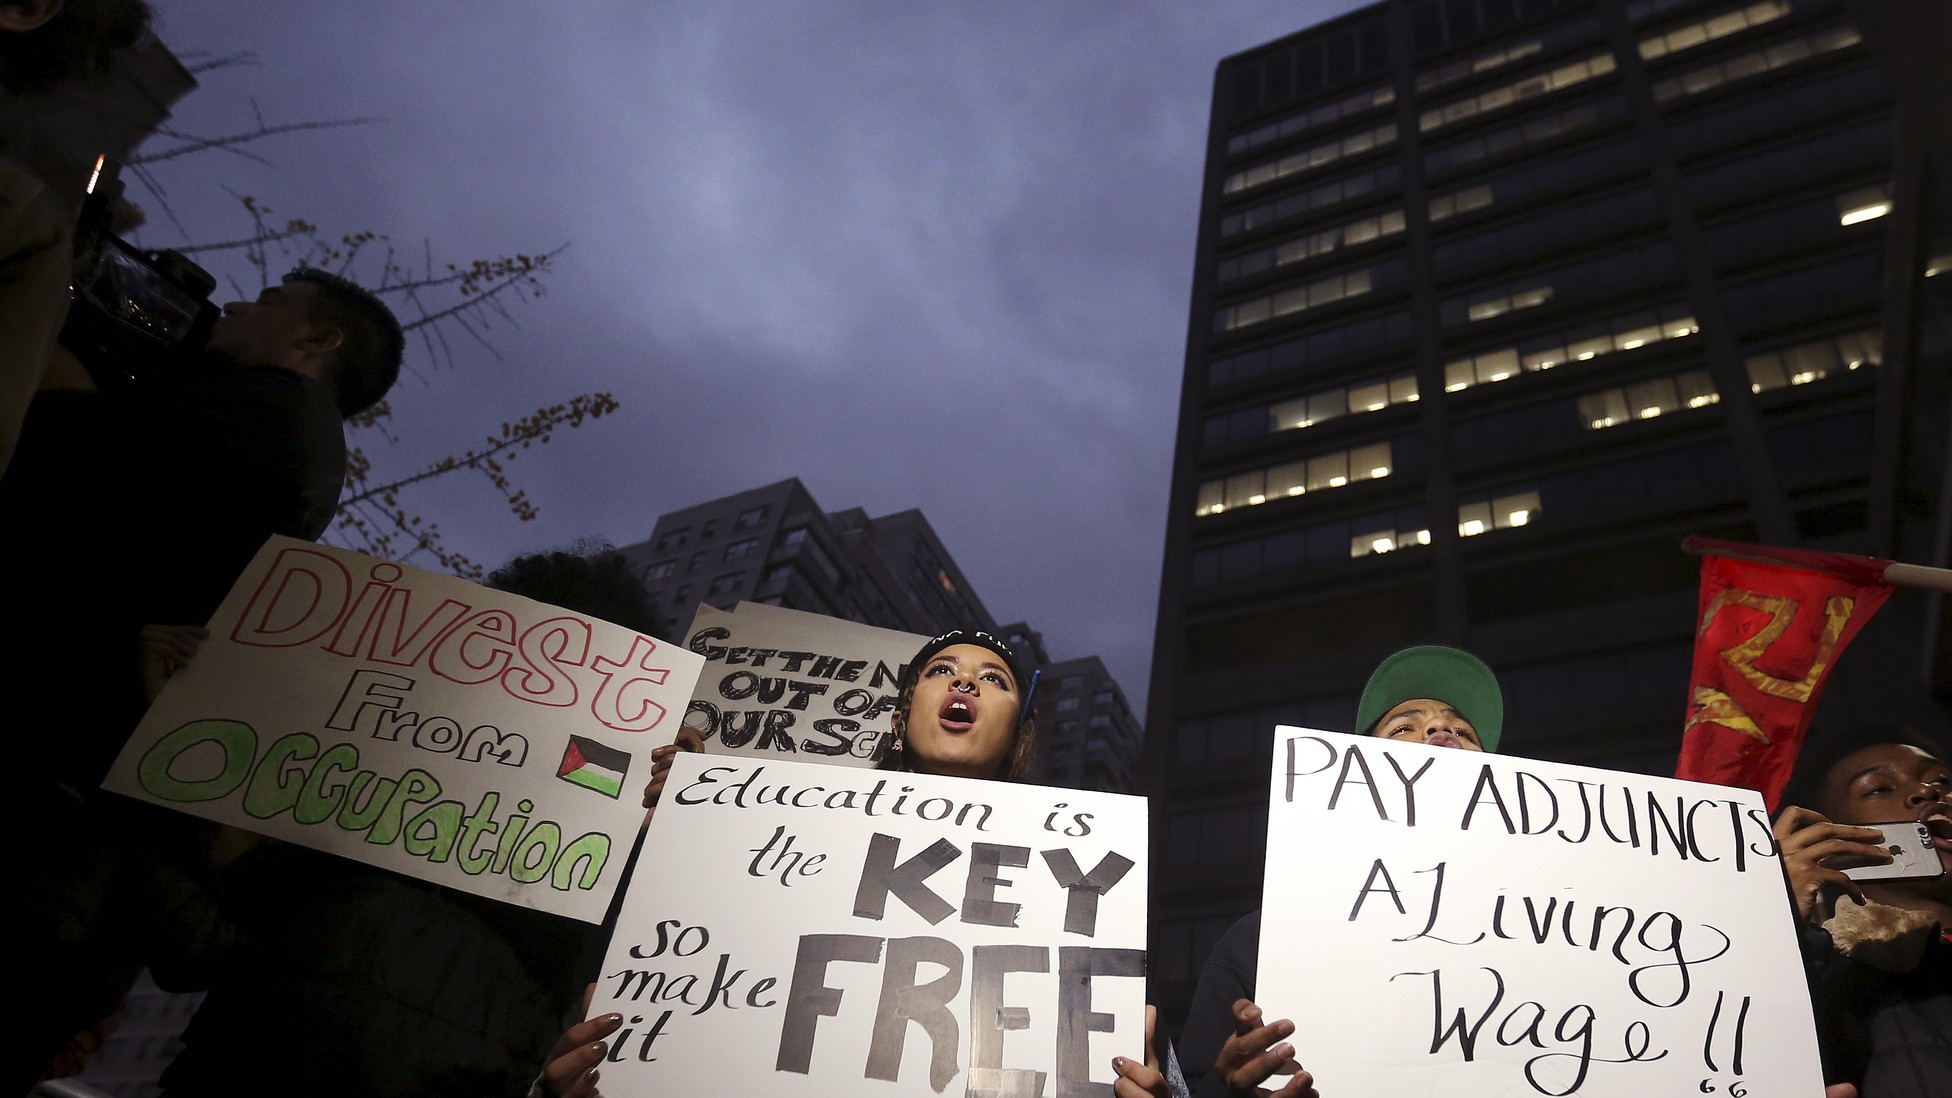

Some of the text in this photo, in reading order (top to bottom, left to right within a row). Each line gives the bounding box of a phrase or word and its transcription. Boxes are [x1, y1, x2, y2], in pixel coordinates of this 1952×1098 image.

[683, 700, 798, 753] OUR
[719, 671, 899, 721] OUT OF
[674, 766, 1095, 837] Education is
[1285, 736, 1778, 873] PAY ADJUNCTS
[748, 825, 1136, 938] the KEY
[629, 919, 709, 960] so
[1348, 858, 1730, 1008] A Living
[607, 954, 777, 1016] make
[775, 933, 1148, 1098] FREE
[607, 1010, 669, 1064] it
